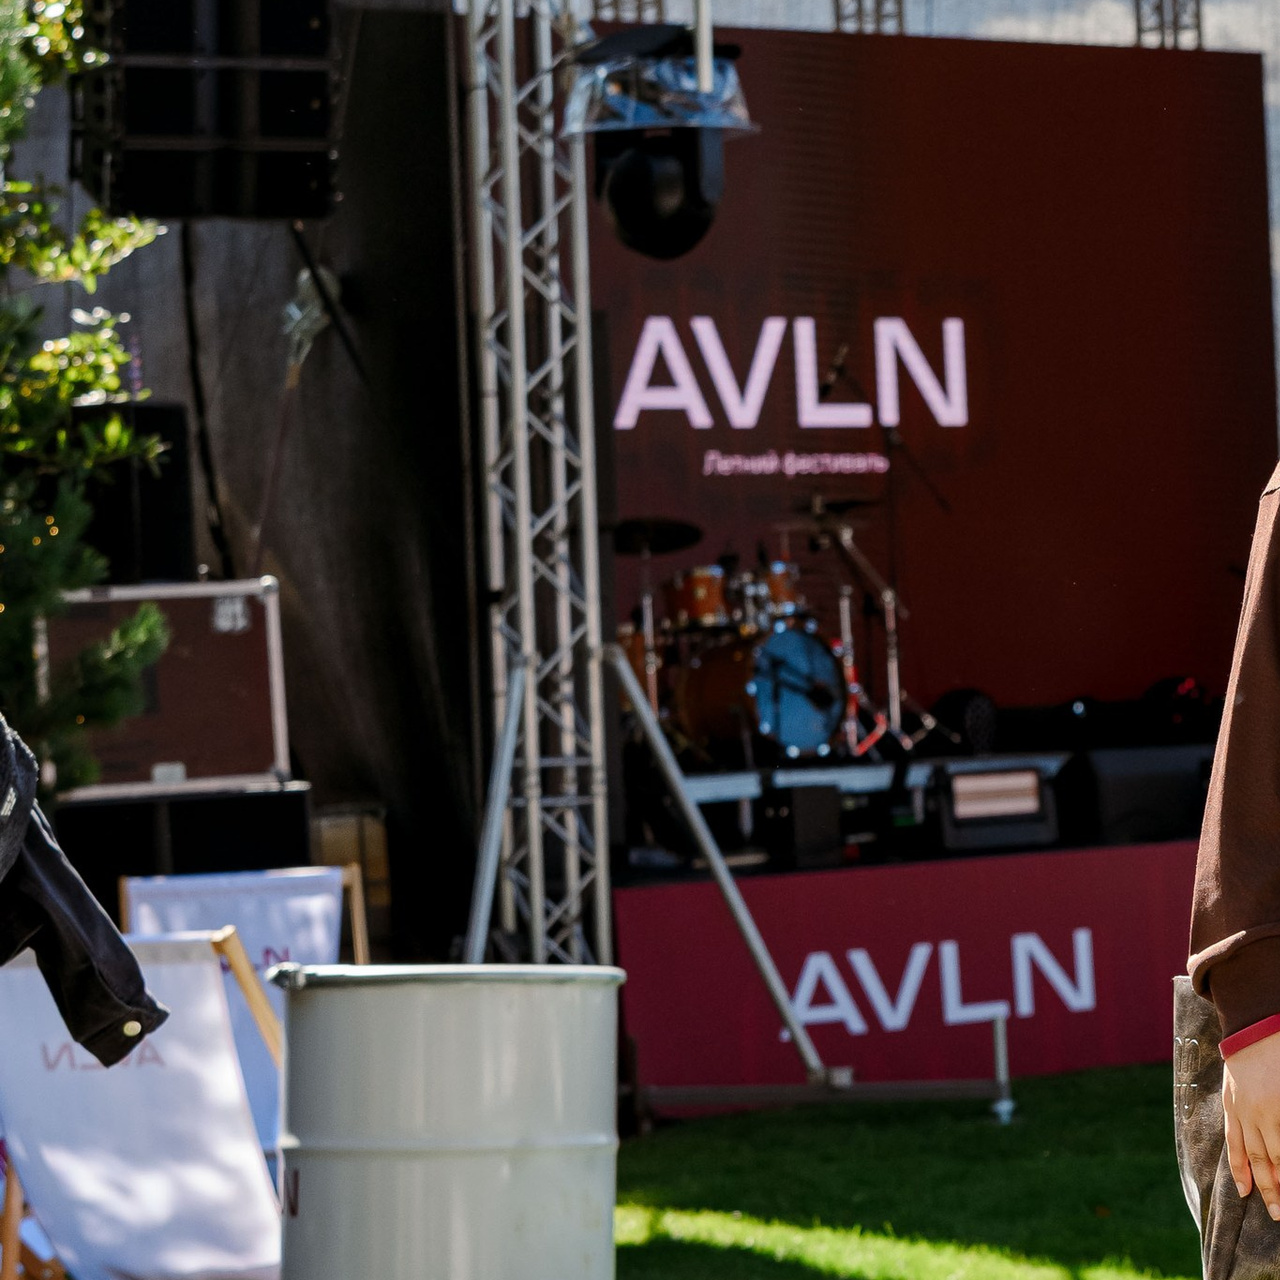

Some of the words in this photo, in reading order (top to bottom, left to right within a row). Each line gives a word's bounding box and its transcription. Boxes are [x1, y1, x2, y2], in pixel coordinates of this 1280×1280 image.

[614, 315, 969, 430] AVLN
[703, 449, 779, 476] Летний
[783, 451, 890, 479] фестиваль
[779, 926, 1096, 1042] AVLN
